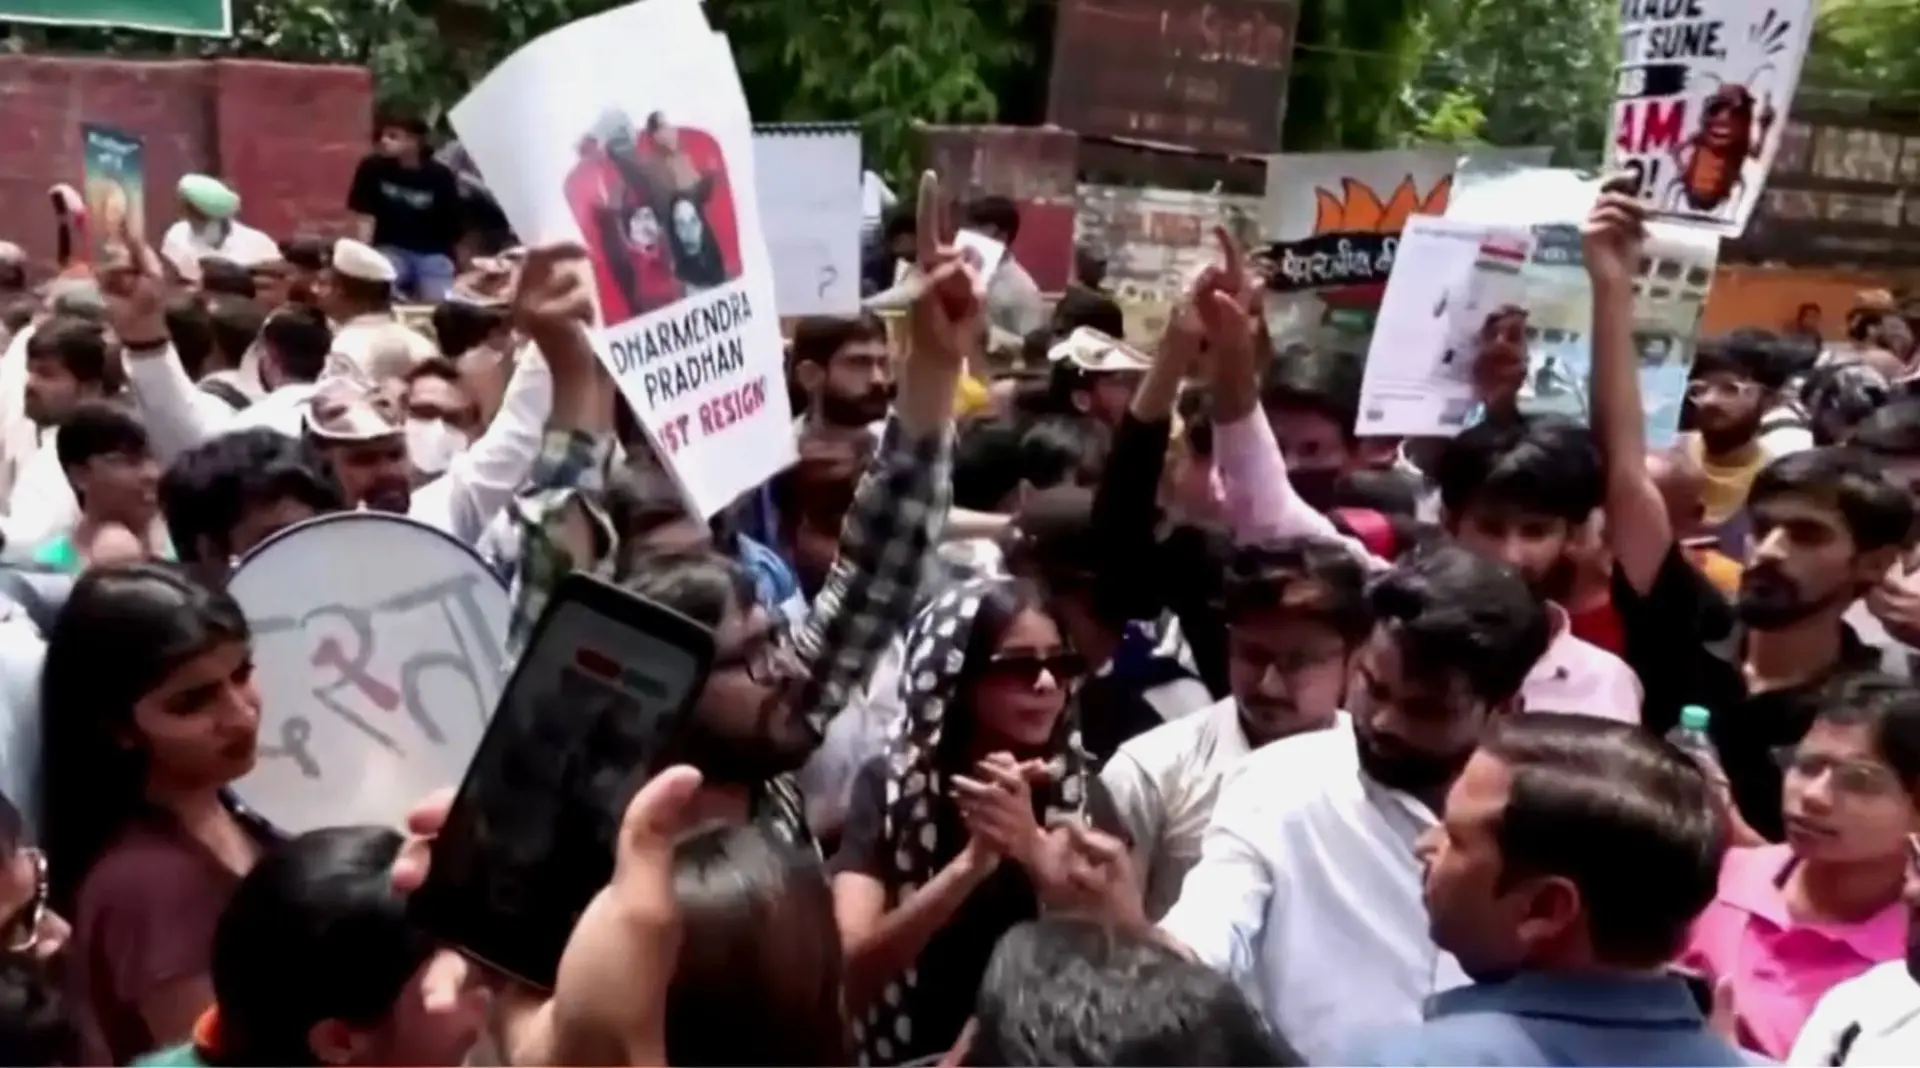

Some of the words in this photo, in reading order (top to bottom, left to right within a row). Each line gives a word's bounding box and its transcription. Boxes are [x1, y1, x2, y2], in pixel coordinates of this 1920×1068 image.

[1646, 21, 1726, 59] SUNE,
[610, 291, 752, 375] DHARMENDRA
[643, 338, 745, 410] PRADHAN
